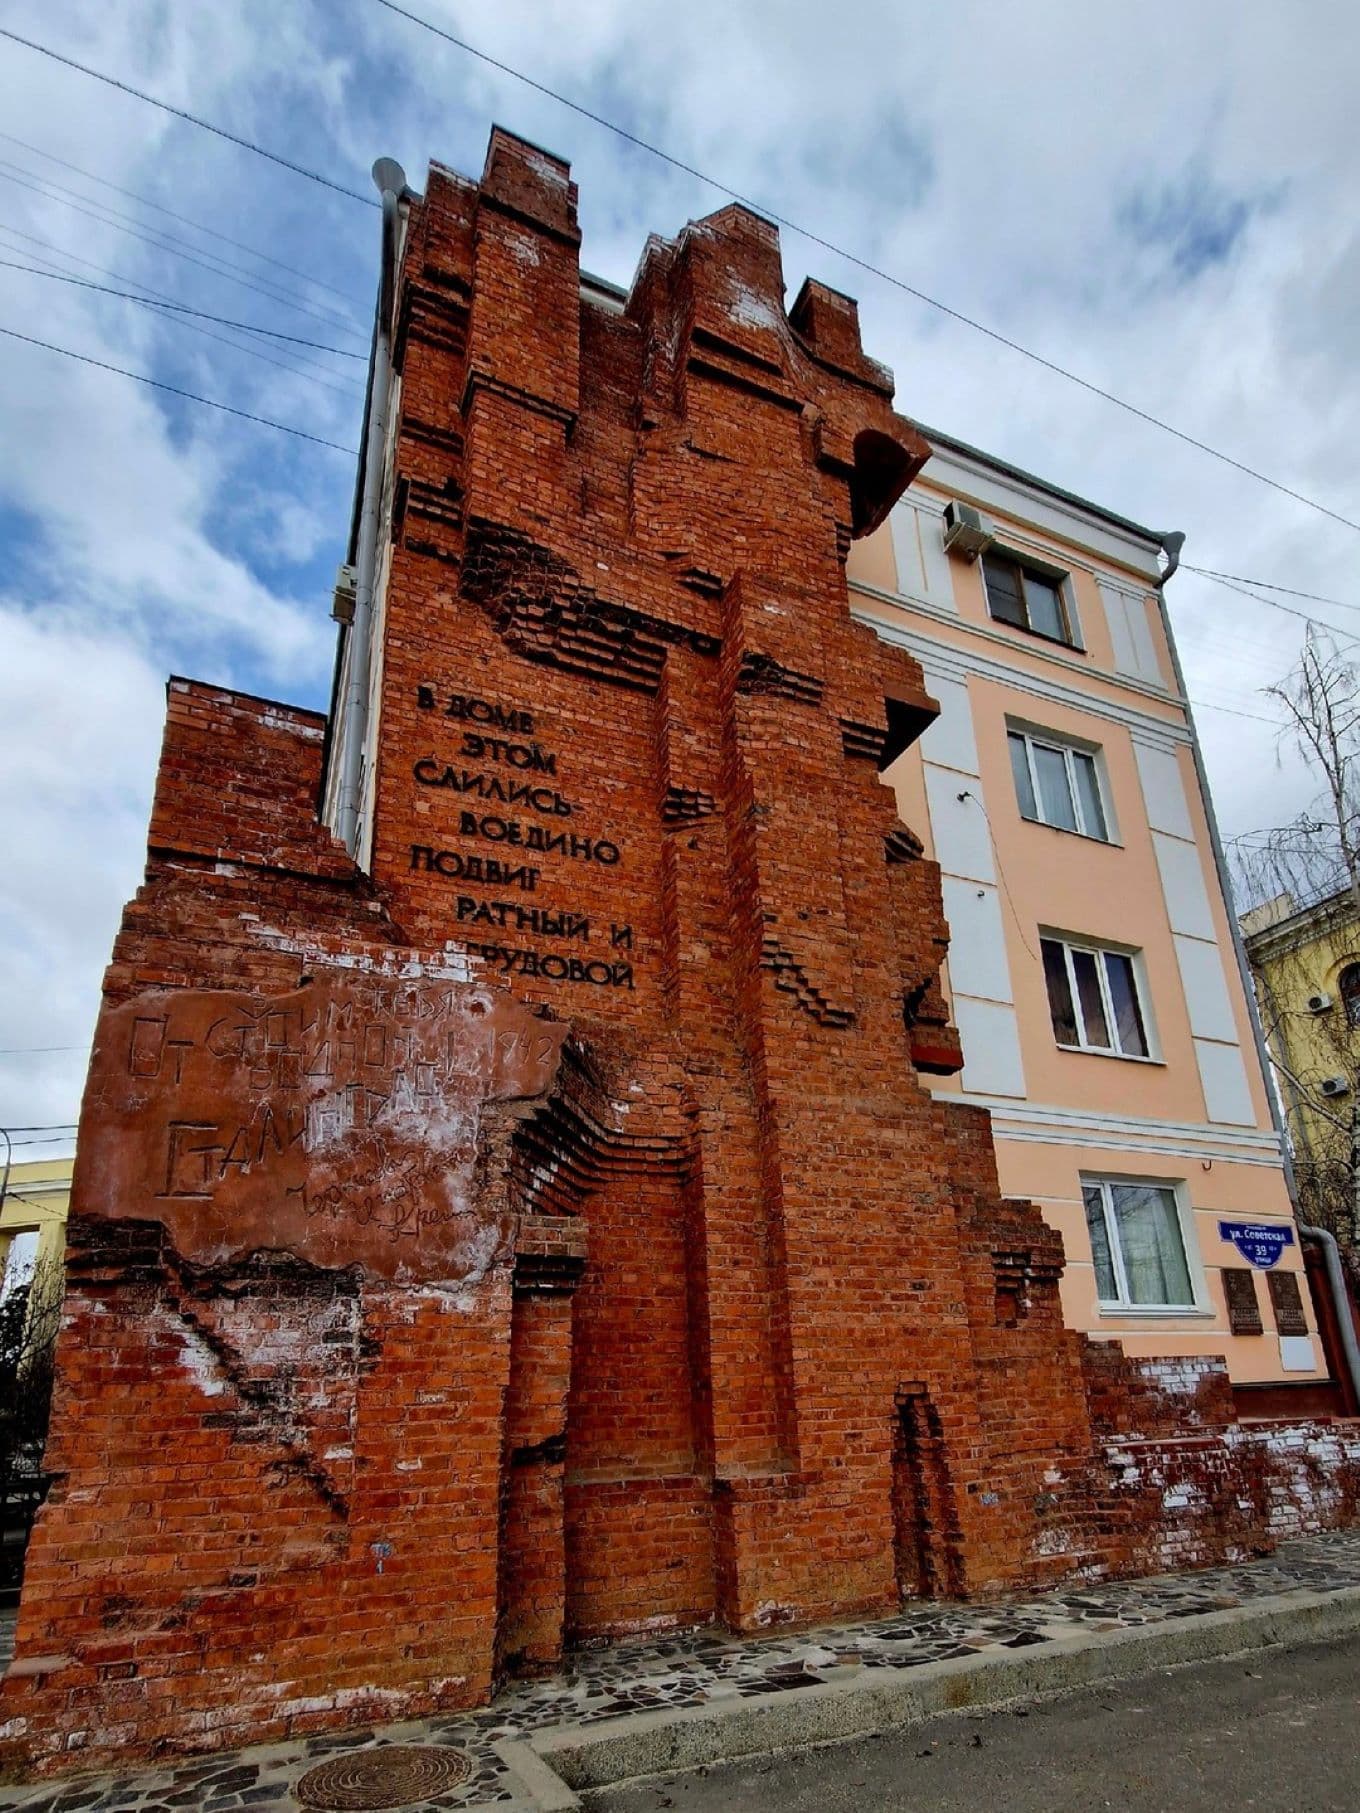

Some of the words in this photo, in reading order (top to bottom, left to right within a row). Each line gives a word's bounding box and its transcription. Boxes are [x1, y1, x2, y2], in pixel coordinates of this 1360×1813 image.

[417, 686, 434, 709] В
[448, 695, 534, 734] ДОМЕ
[462, 734, 556, 774] ЭТОМ
[413, 760, 572, 816] СЛИЛИСЬ
[460, 812, 620, 865] ВОЕДИНО
[409, 844, 541, 891] ПОДВИГ
[456, 896, 590, 941] РАТНЫЙ
[610, 923, 633, 949] И
[1255, 1245, 1267, 1255] 39
